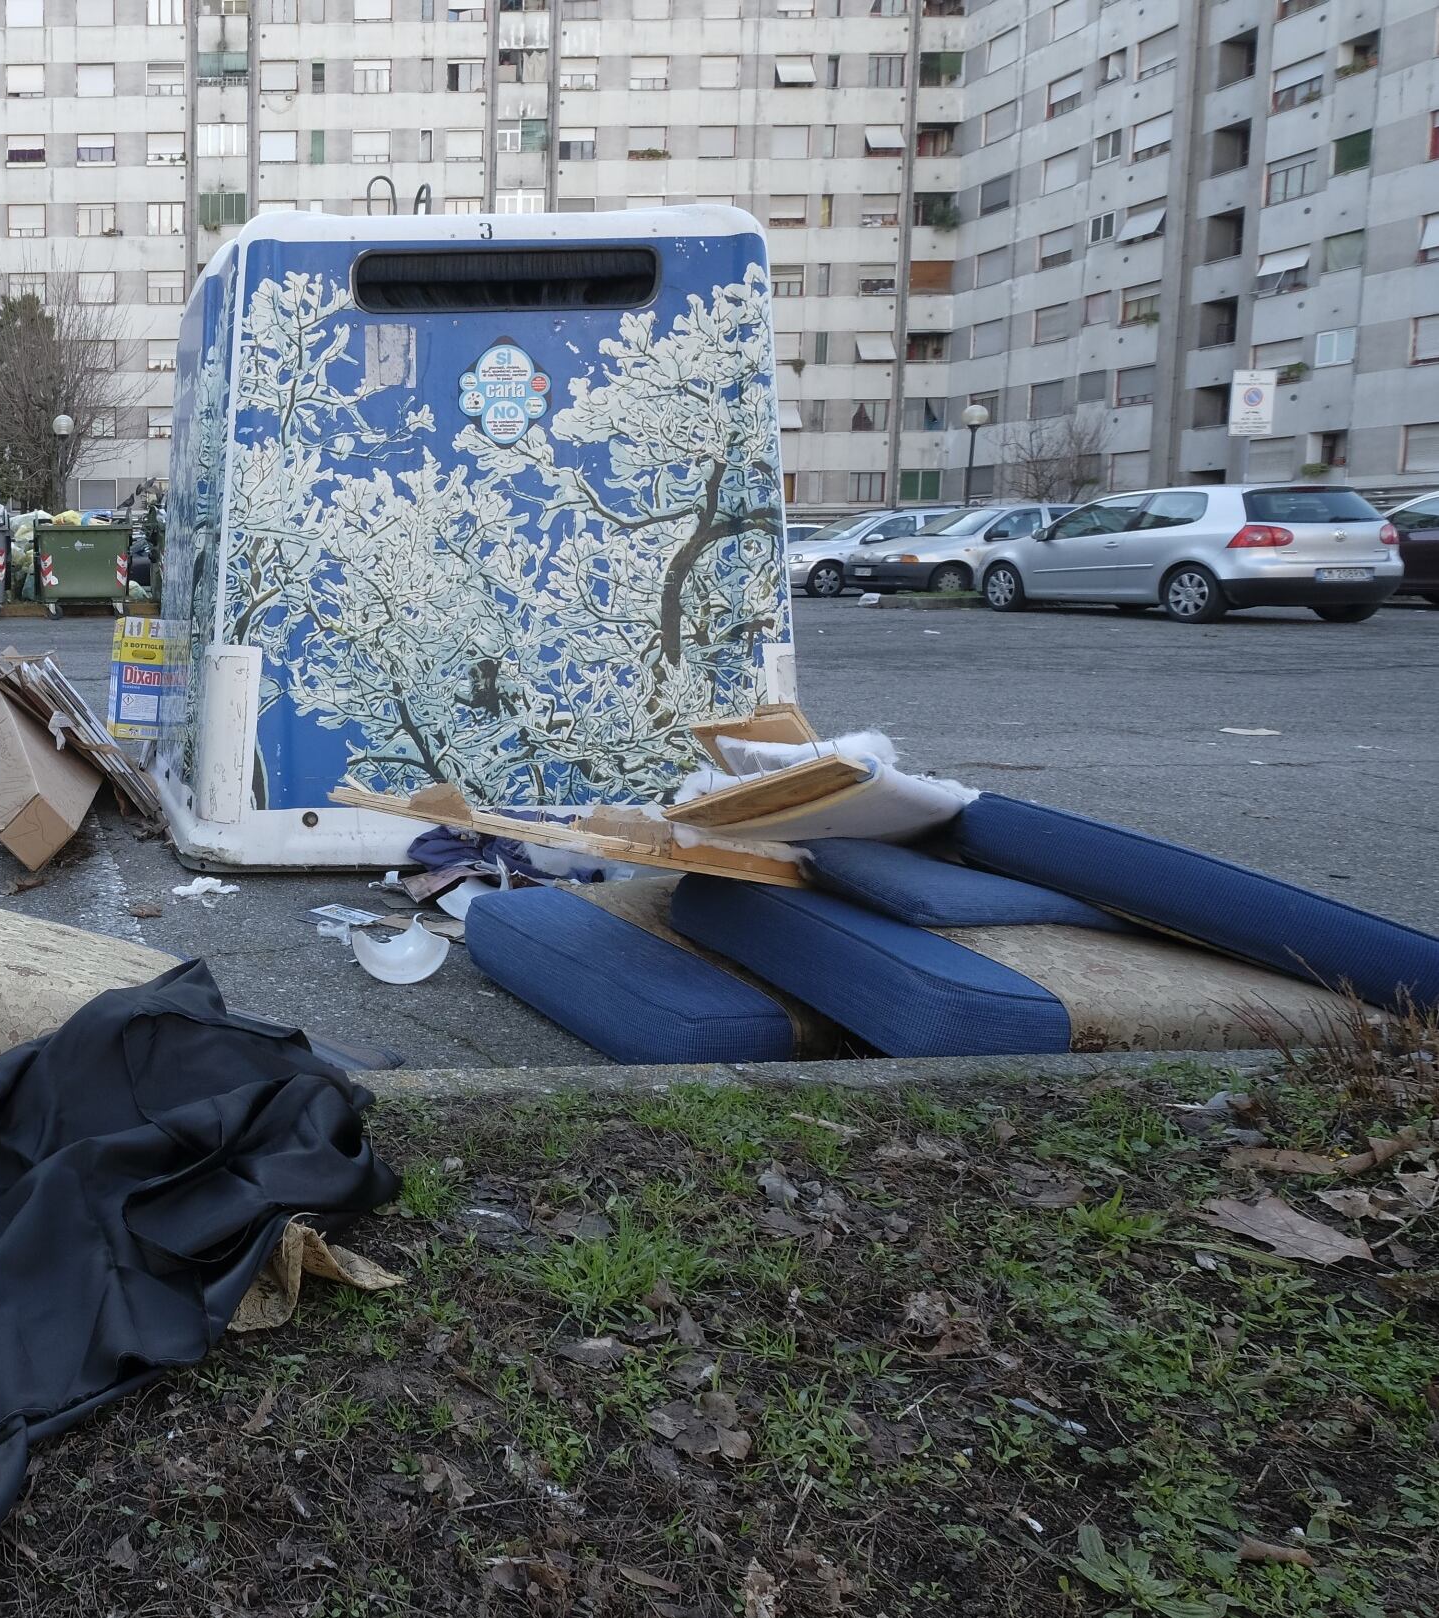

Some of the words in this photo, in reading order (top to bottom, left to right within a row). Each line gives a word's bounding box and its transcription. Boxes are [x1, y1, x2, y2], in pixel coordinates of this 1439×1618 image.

[479, 222, 493, 240] 3
[496, 349, 512, 365] SÌ
[486, 382, 526, 398] carta
[493, 406, 519, 419] NO
[123, 665, 162, 686] Dixan
